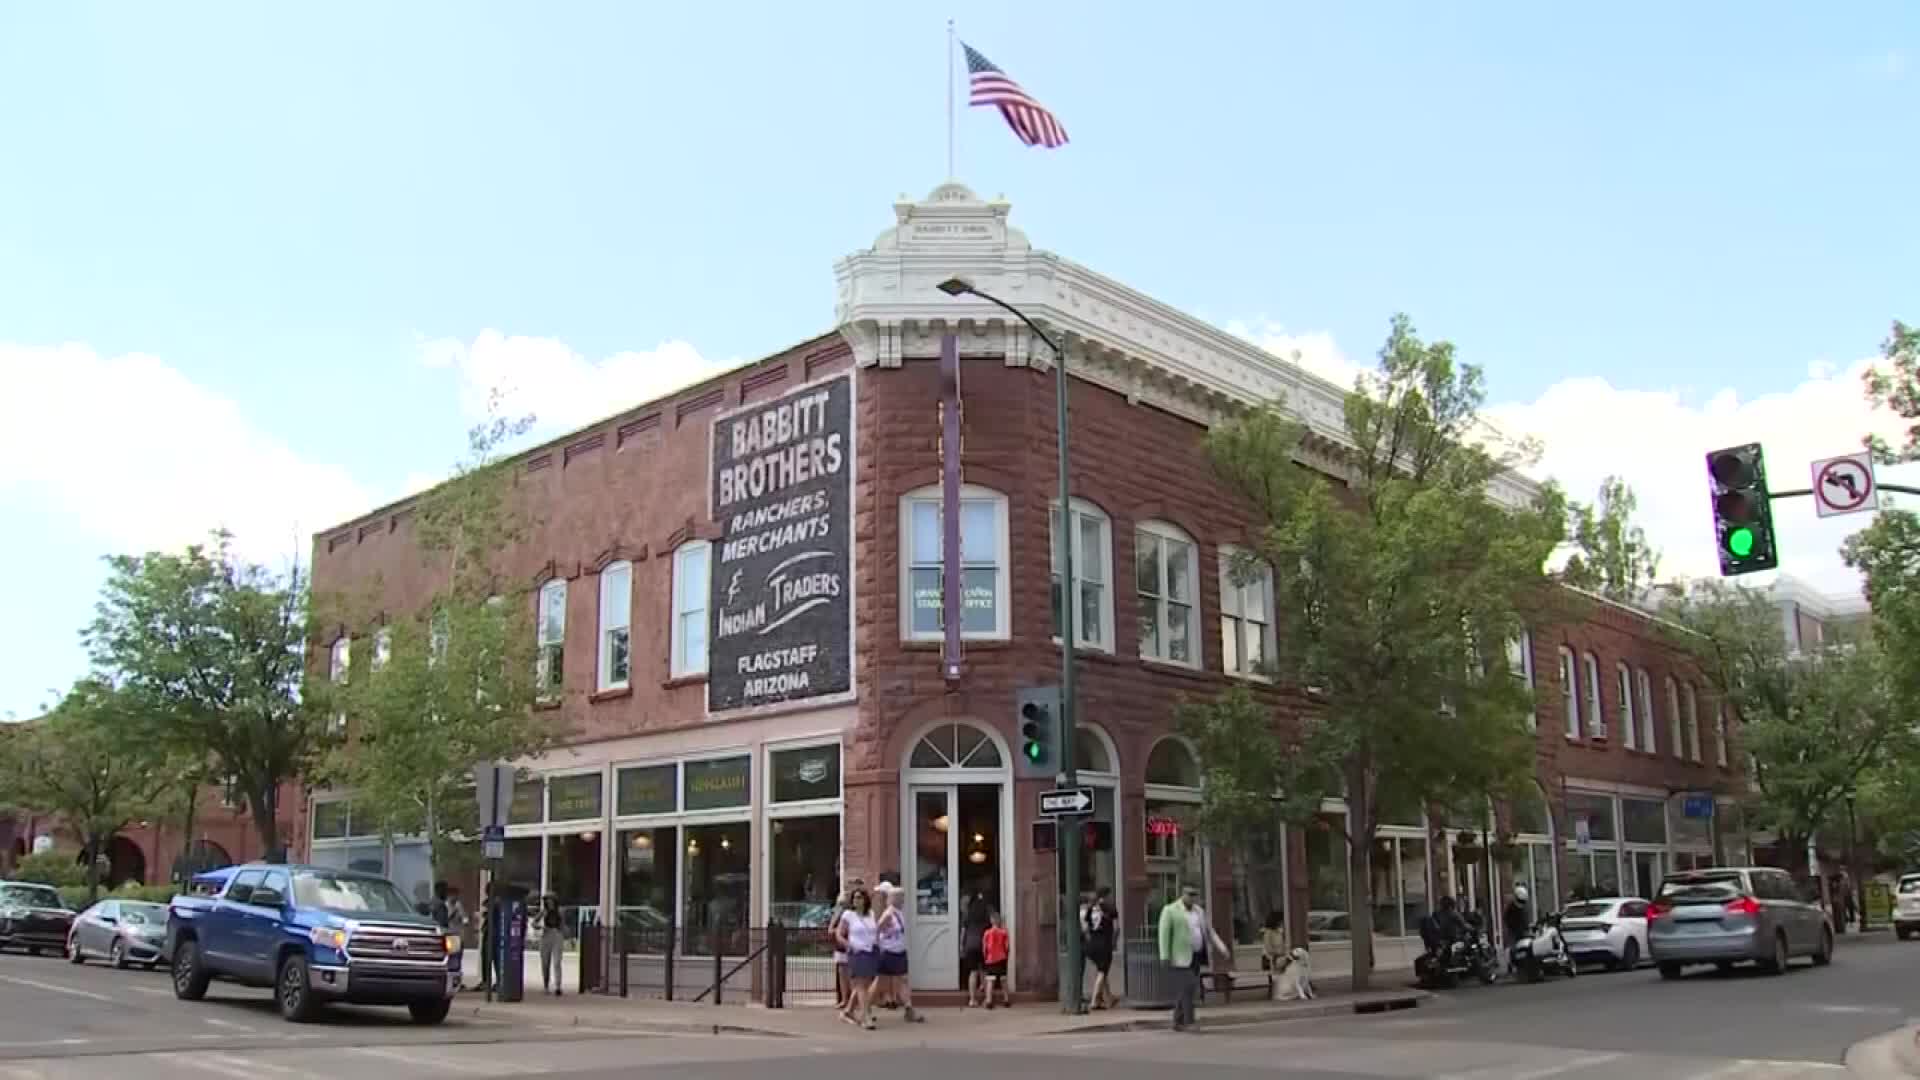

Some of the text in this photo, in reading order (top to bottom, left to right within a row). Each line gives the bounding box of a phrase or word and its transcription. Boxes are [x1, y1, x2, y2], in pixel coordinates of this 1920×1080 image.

[732, 391, 829, 459] BABBITT
[719, 433, 842, 506] BROTHERS
[721, 513, 830, 563] MERCHANTS
[737, 644, 817, 675] FLAGSTAFF
[743, 671, 810, 697] ARIZONA
